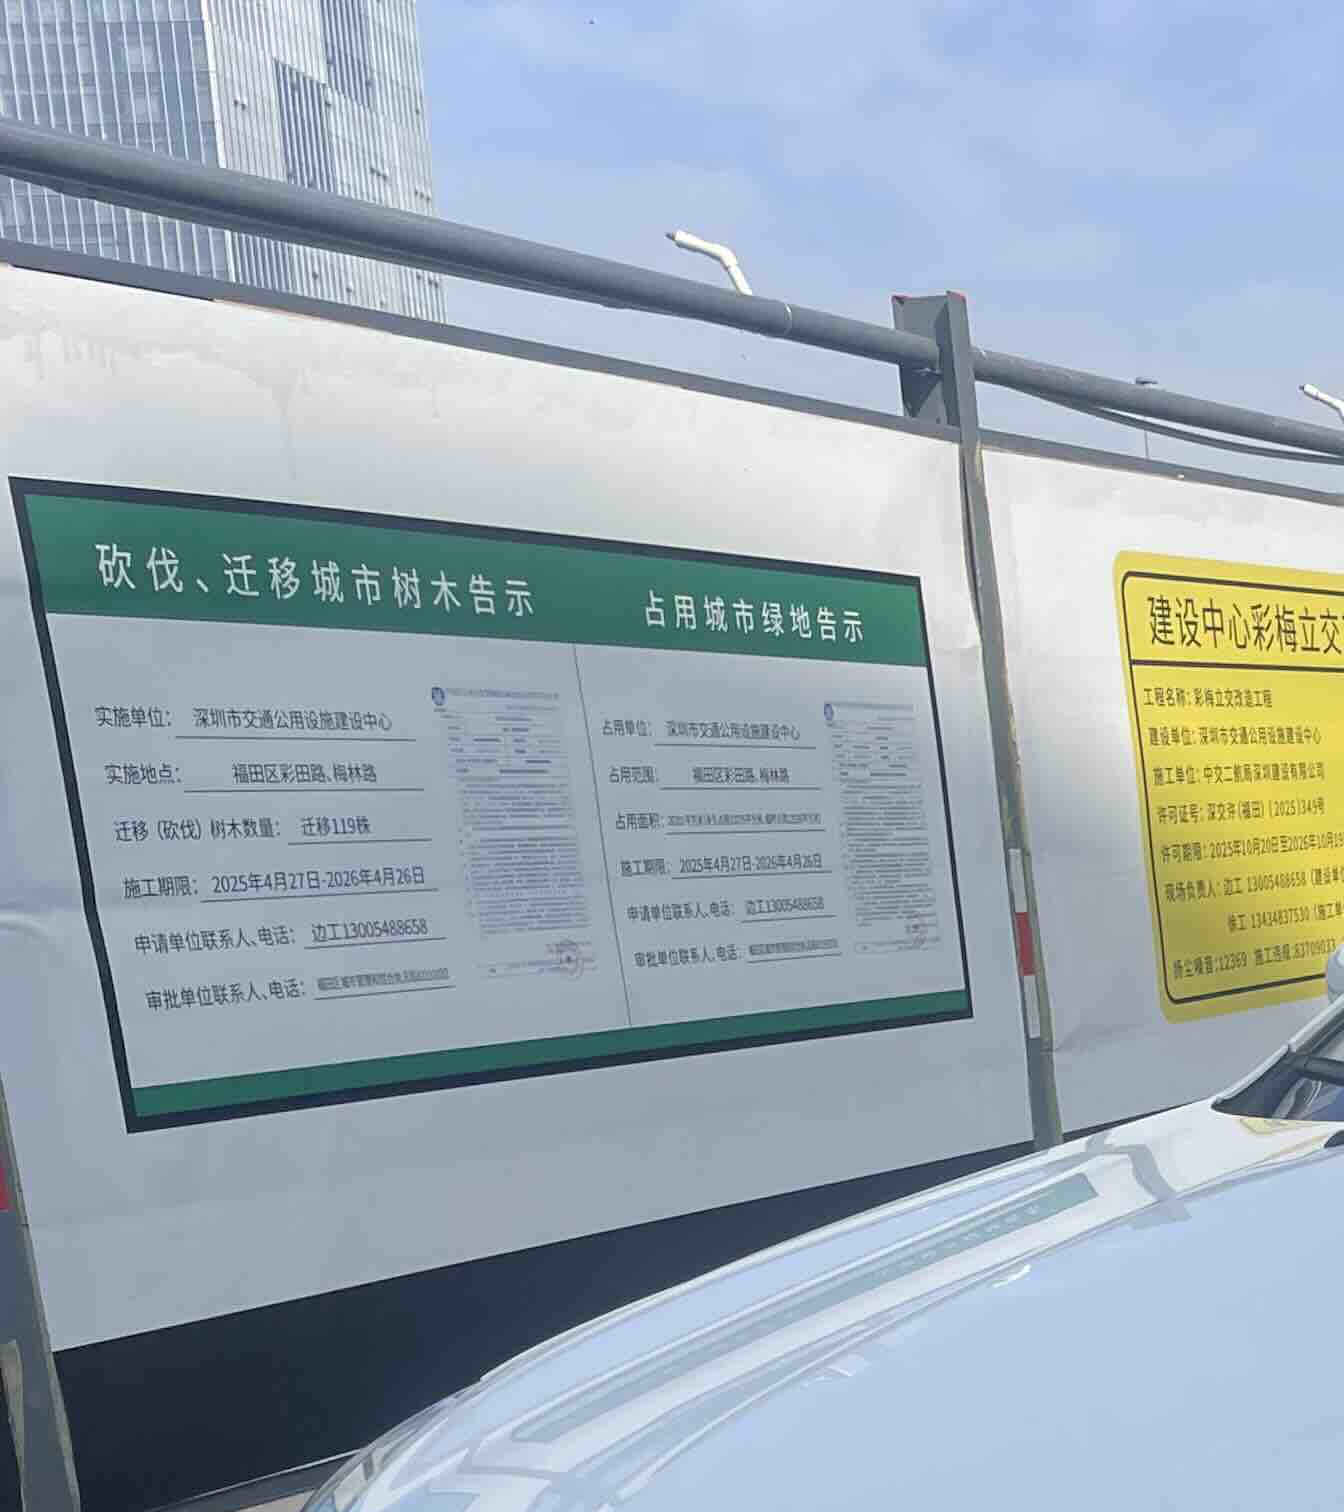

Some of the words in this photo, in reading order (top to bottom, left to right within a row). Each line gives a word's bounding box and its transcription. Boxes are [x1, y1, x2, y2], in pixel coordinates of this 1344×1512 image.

[95, 543, 535, 617] 砍伐、迁移城市树木告示
[645, 590, 864, 643] 占用城市绿地告示
[192, 707, 393, 731] 深圳市交通公用设施建设中心
